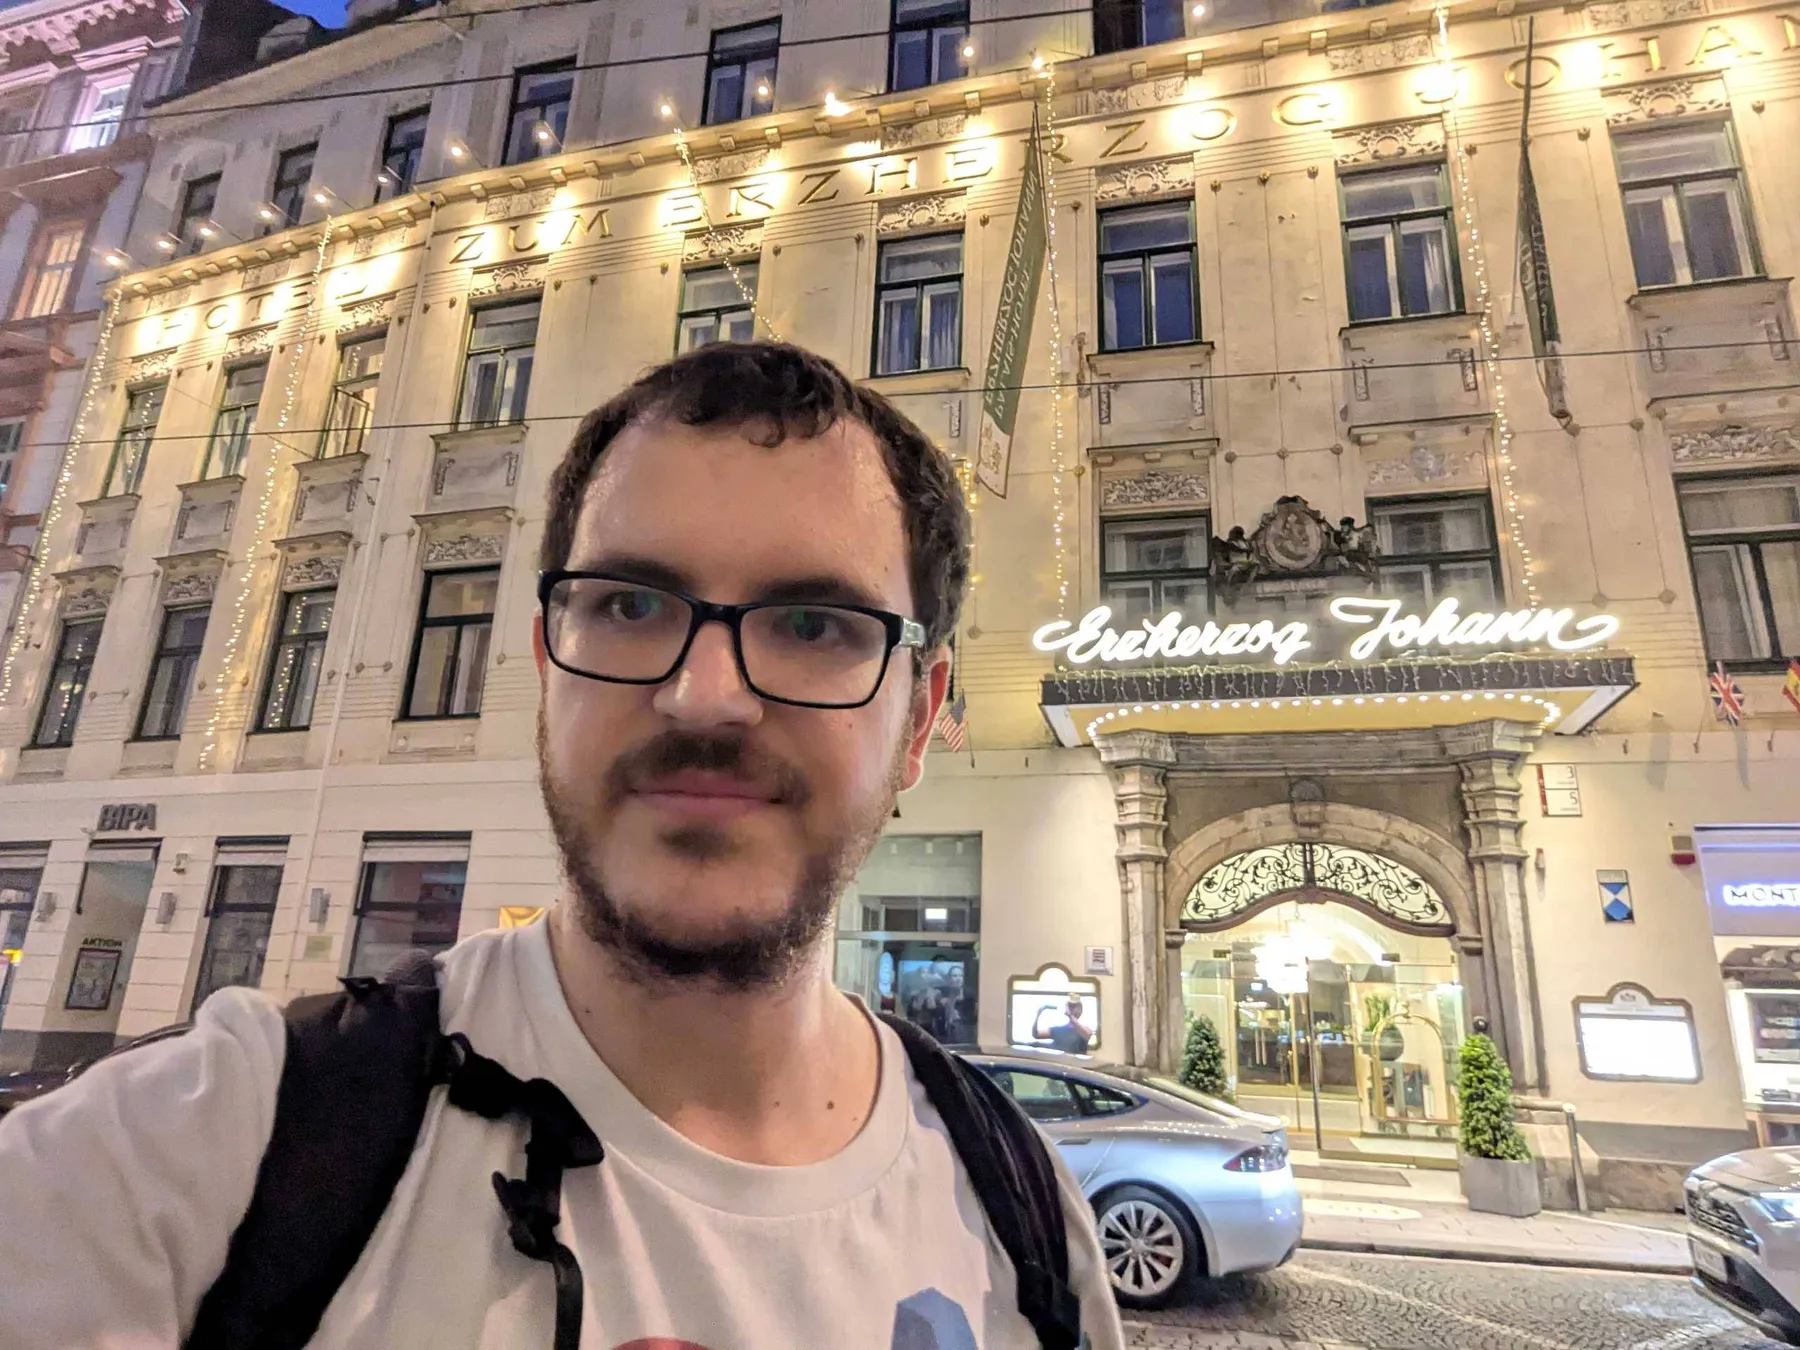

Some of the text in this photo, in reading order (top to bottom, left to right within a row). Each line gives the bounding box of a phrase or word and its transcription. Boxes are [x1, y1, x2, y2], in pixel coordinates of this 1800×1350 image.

[449, 208, 613, 264] ZUM
[661, 92, 1334, 228] ERZHERZOG
[1033, 597, 1619, 664] Erzherzog Johann
[1567, 765, 1575, 779] 3
[1569, 791, 1578, 805] 5
[97, 804, 157, 830] BIPA
[82, 937, 122, 947] AKTION
